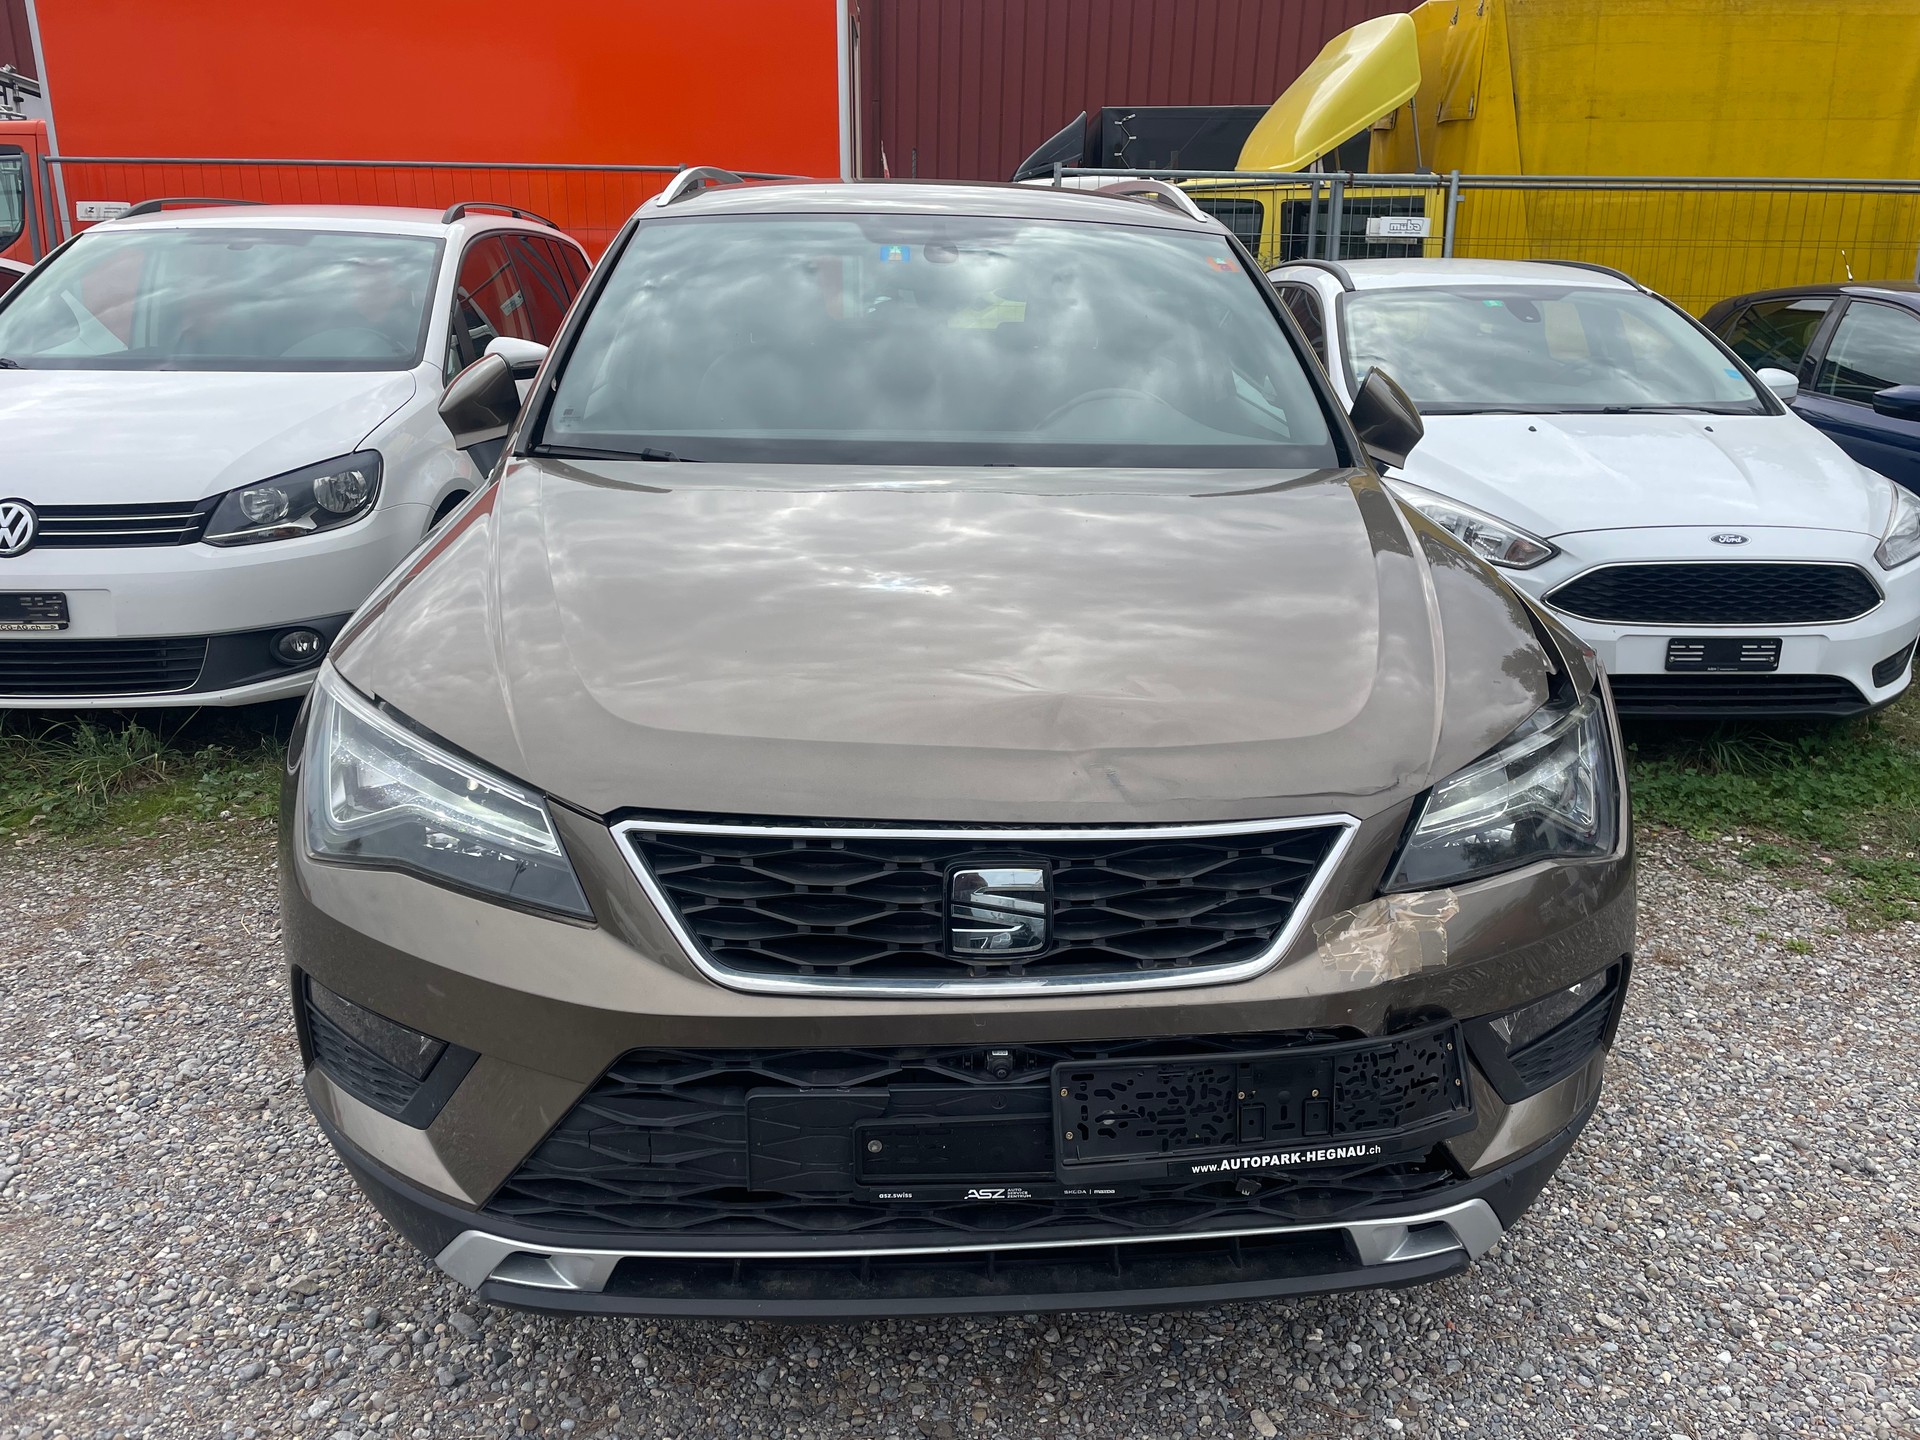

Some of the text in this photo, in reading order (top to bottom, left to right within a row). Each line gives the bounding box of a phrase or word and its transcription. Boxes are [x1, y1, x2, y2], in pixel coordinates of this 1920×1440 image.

[1718, 535, 1743, 543] Ford
[1191, 1144, 1382, 1174] www.AUTOPARK-HEGNAU.ch
[963, 1188, 1006, 1200] ASZ
